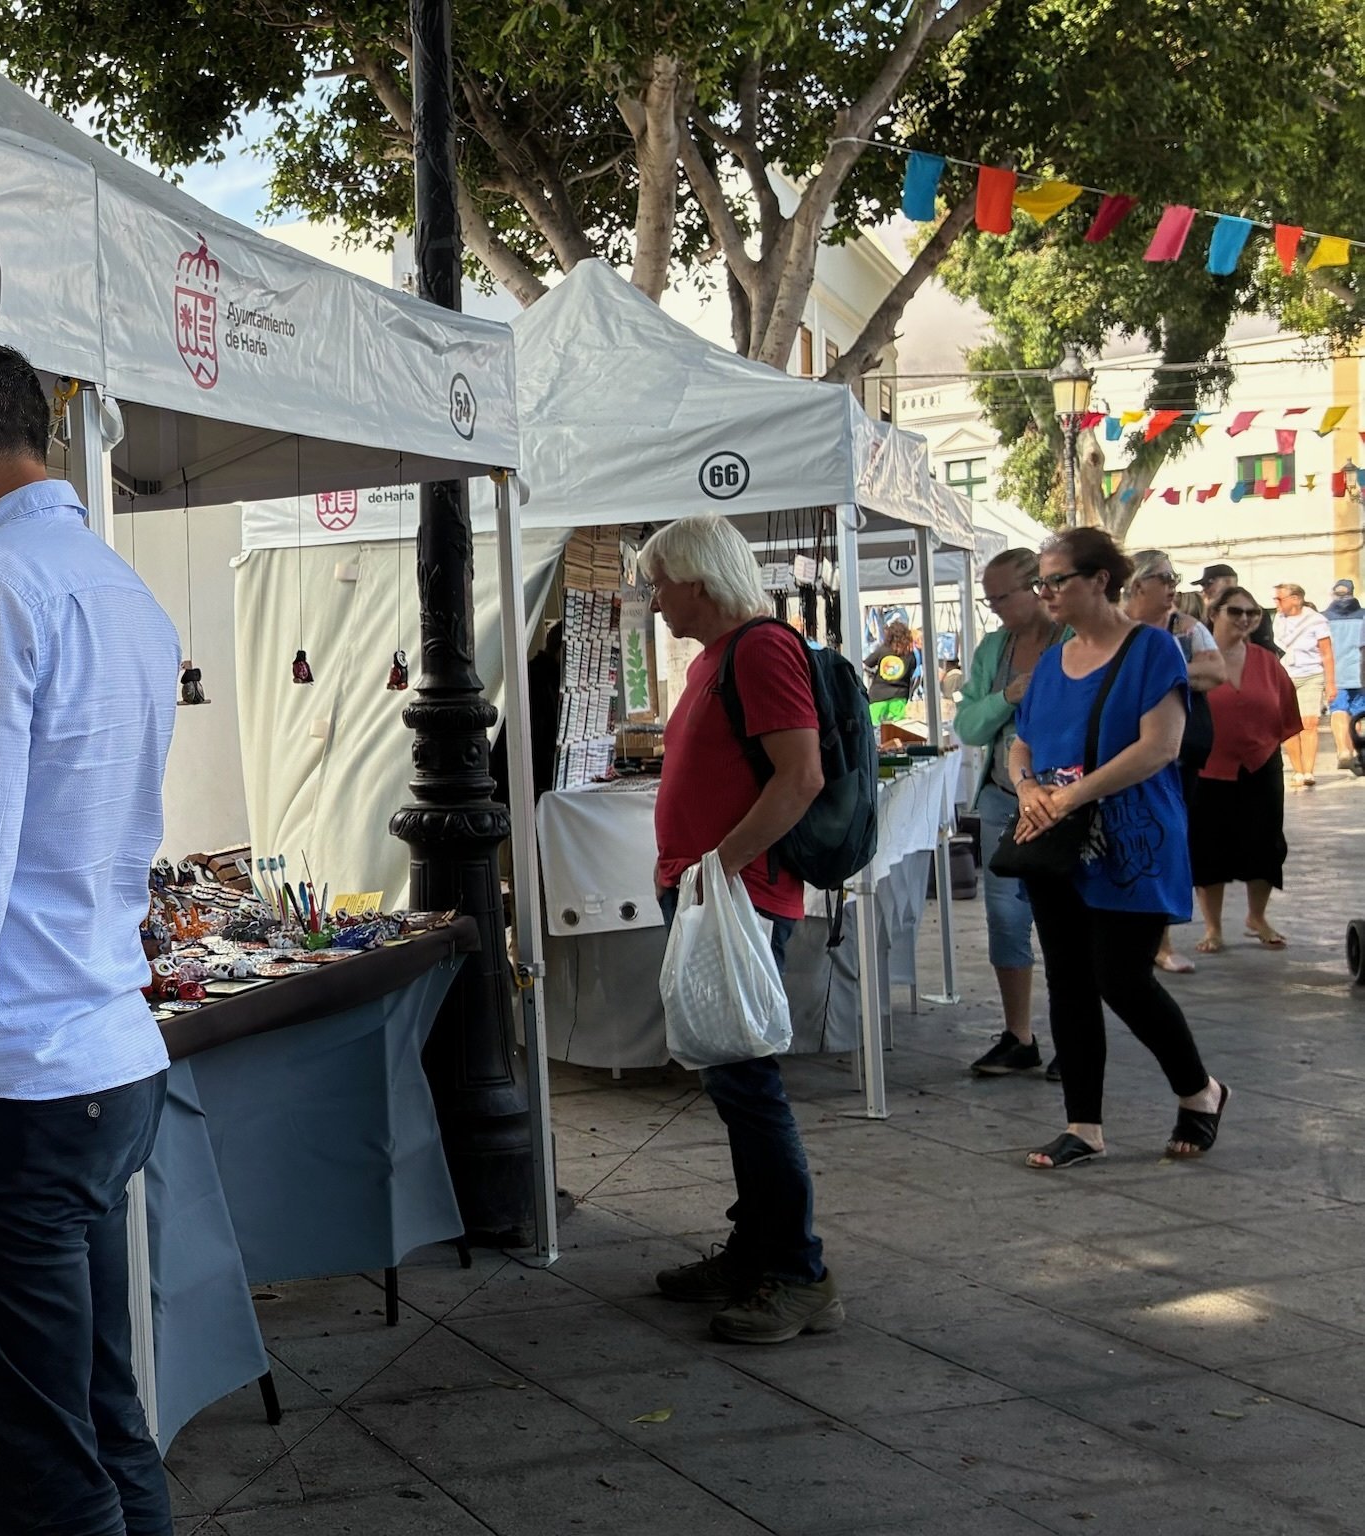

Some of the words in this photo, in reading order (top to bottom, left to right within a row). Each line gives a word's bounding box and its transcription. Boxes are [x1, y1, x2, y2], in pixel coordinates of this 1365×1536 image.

[226, 301, 296, 337] Ayuntamiento
[225, 329, 240, 350] de
[454, 391, 471, 424] 54
[709, 463, 739, 488] 66
[368, 493, 383, 503] de
[384, 489, 415, 503] Haría
[894, 558, 908, 571] 78
